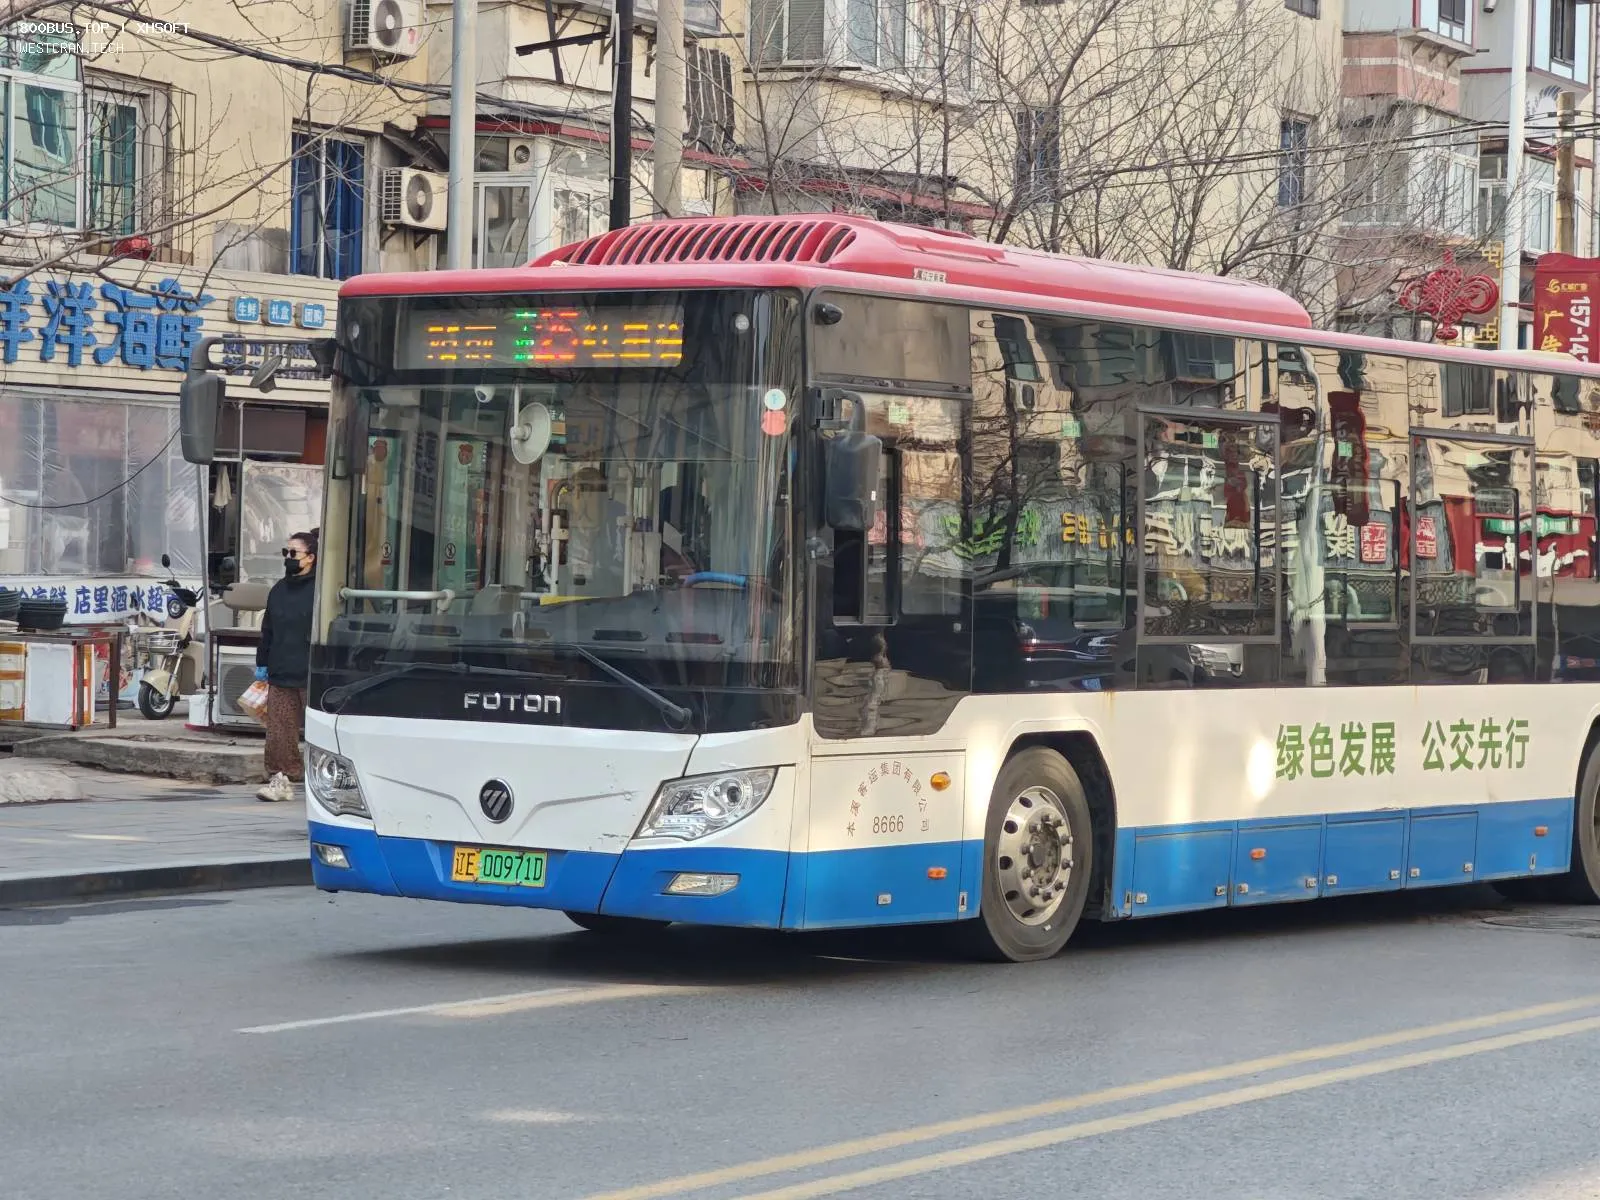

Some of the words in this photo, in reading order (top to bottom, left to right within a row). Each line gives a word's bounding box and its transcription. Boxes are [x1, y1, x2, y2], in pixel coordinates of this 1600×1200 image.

[237, 301, 258, 319] 生鲜
[464, 692, 561, 714] FOTON
[1275, 721, 1397, 781] 绿色发展
[1421, 716, 1530, 772] 公交先行
[872, 814, 904, 834] 8666
[483, 854, 544, 881] 00971D
